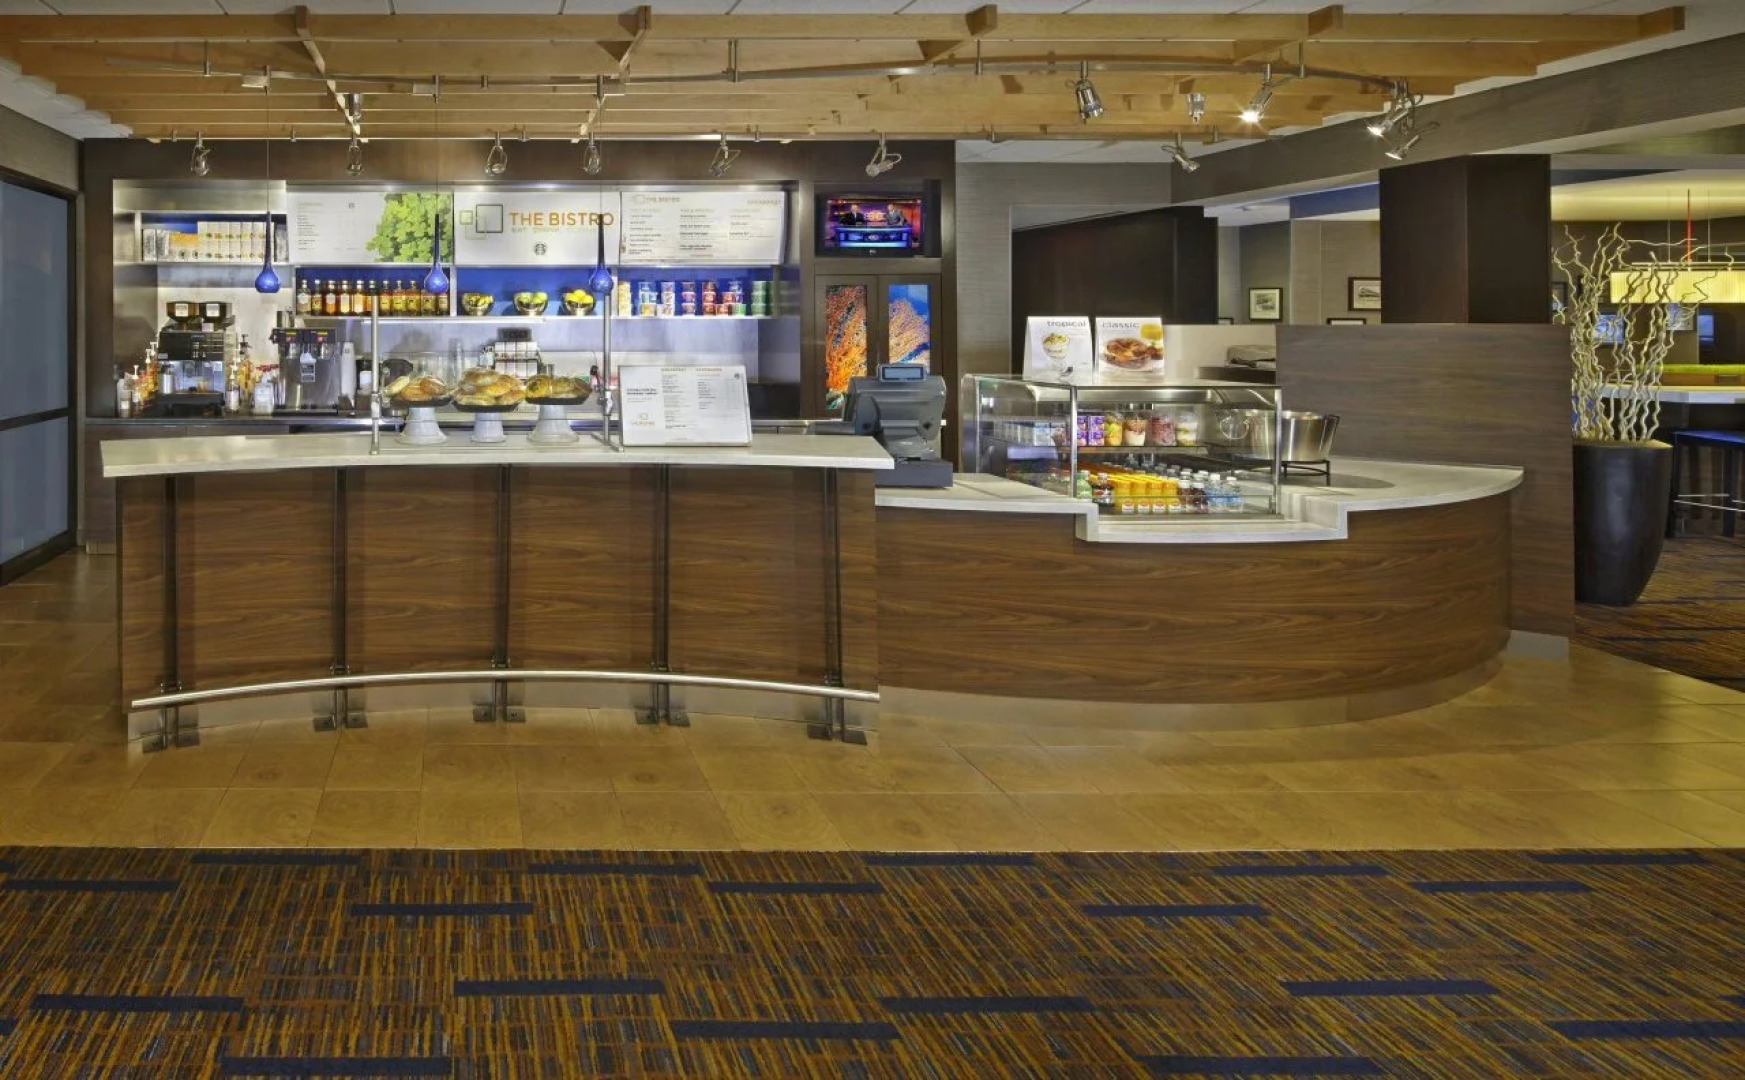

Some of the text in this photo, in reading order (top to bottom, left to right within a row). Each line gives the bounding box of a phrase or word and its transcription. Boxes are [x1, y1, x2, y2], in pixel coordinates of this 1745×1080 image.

[509, 212, 615, 226] THE BISTRO
[1046, 320, 1086, 328] tropical
[1102, 321, 1139, 329] classic
